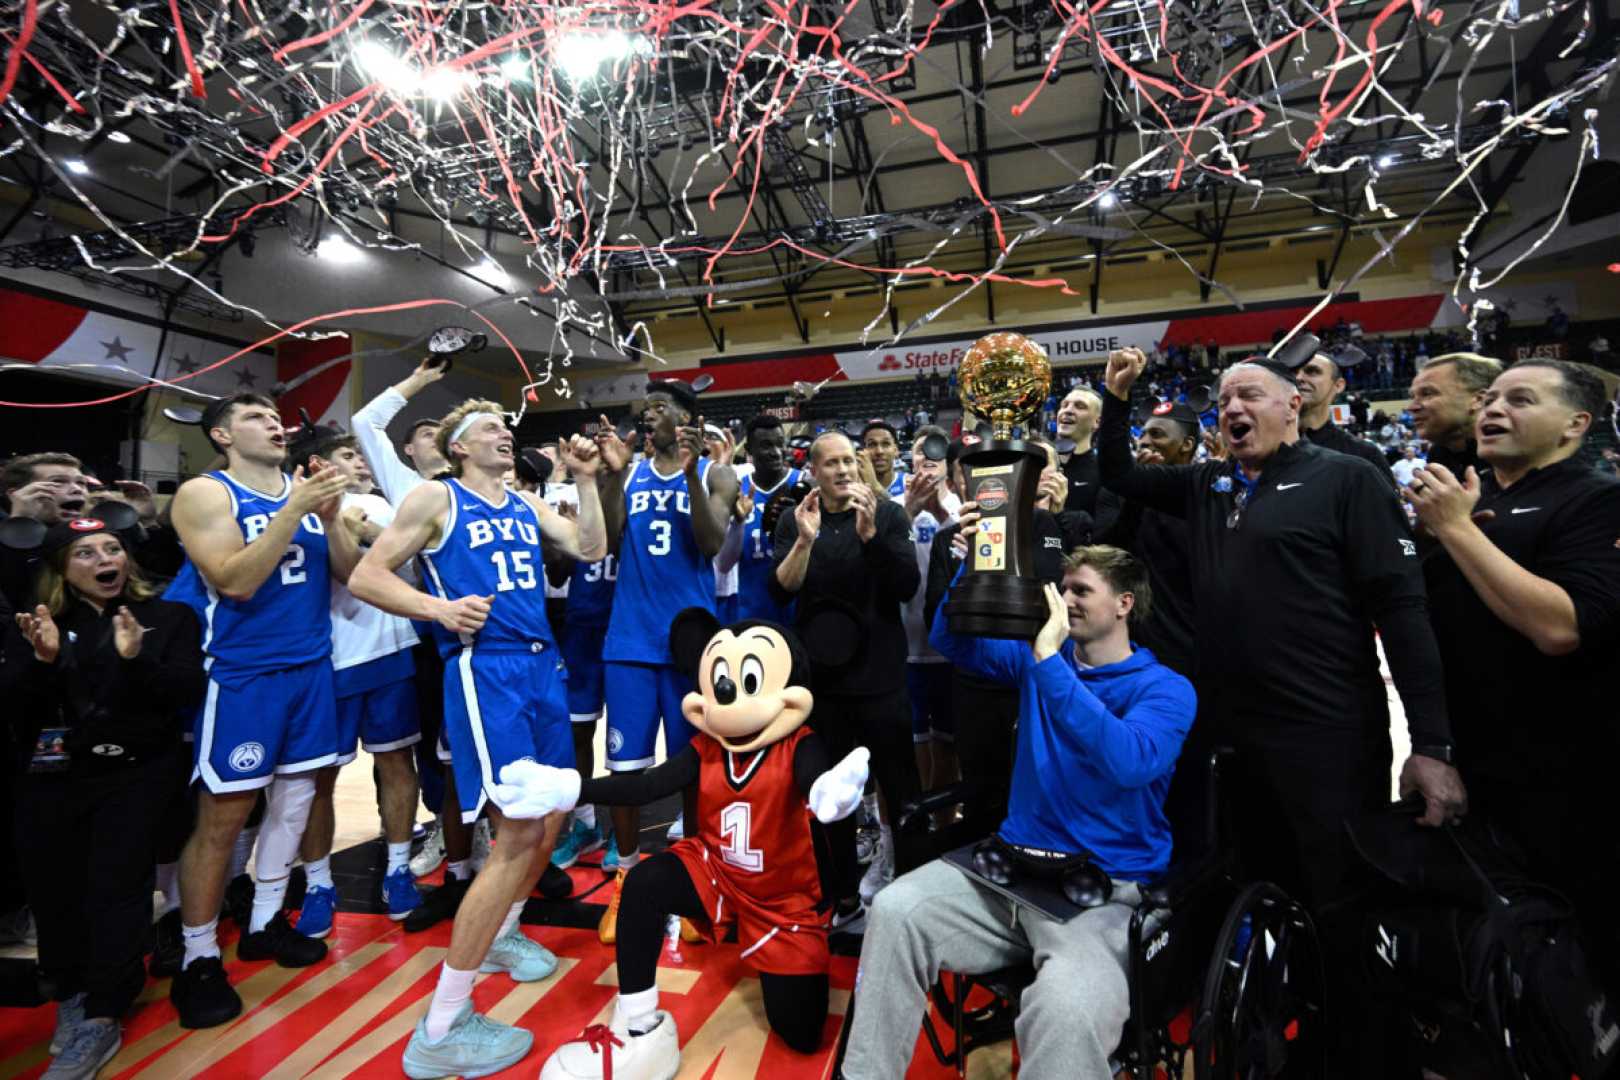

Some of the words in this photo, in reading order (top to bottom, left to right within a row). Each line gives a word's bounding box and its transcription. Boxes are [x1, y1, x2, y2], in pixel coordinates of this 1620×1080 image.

[1056, 336, 1119, 356] HOUSE
[629, 489, 691, 516] BYU
[243, 512, 326, 544] BU
[466, 517, 540, 549] BYU
[648, 520, 672, 556] 3
[280, 543, 308, 586] 2
[978, 543, 993, 558] G
[490, 550, 538, 592] 15
[719, 801, 765, 873] 1
